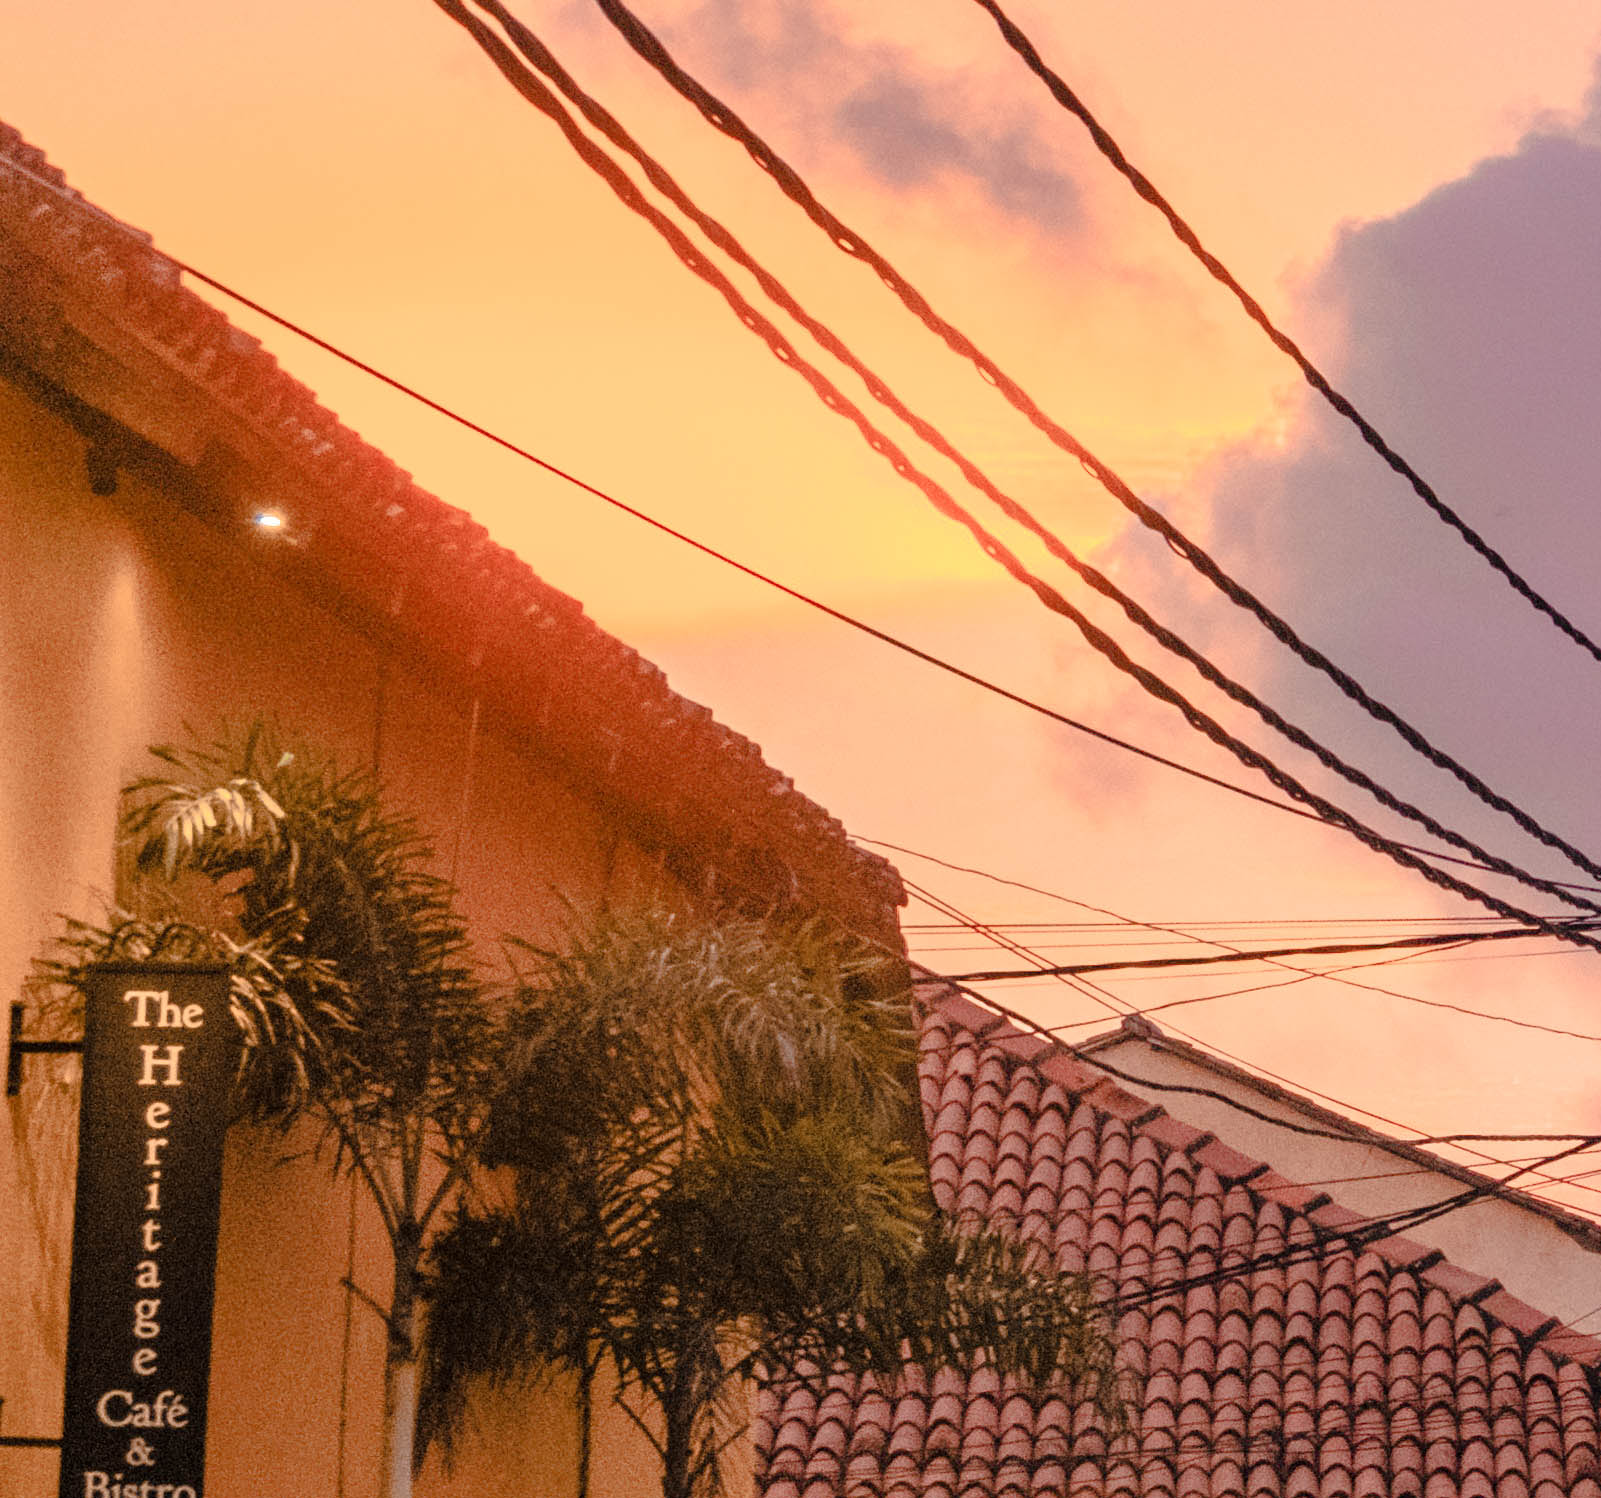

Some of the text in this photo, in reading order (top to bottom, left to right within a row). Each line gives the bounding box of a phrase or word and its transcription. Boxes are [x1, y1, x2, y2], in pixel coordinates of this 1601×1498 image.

[123, 990, 204, 1029] The
[132, 1045, 185, 1377] Heritage
[96, 1389, 190, 1428] Café
[125, 1437, 156, 1467] &
